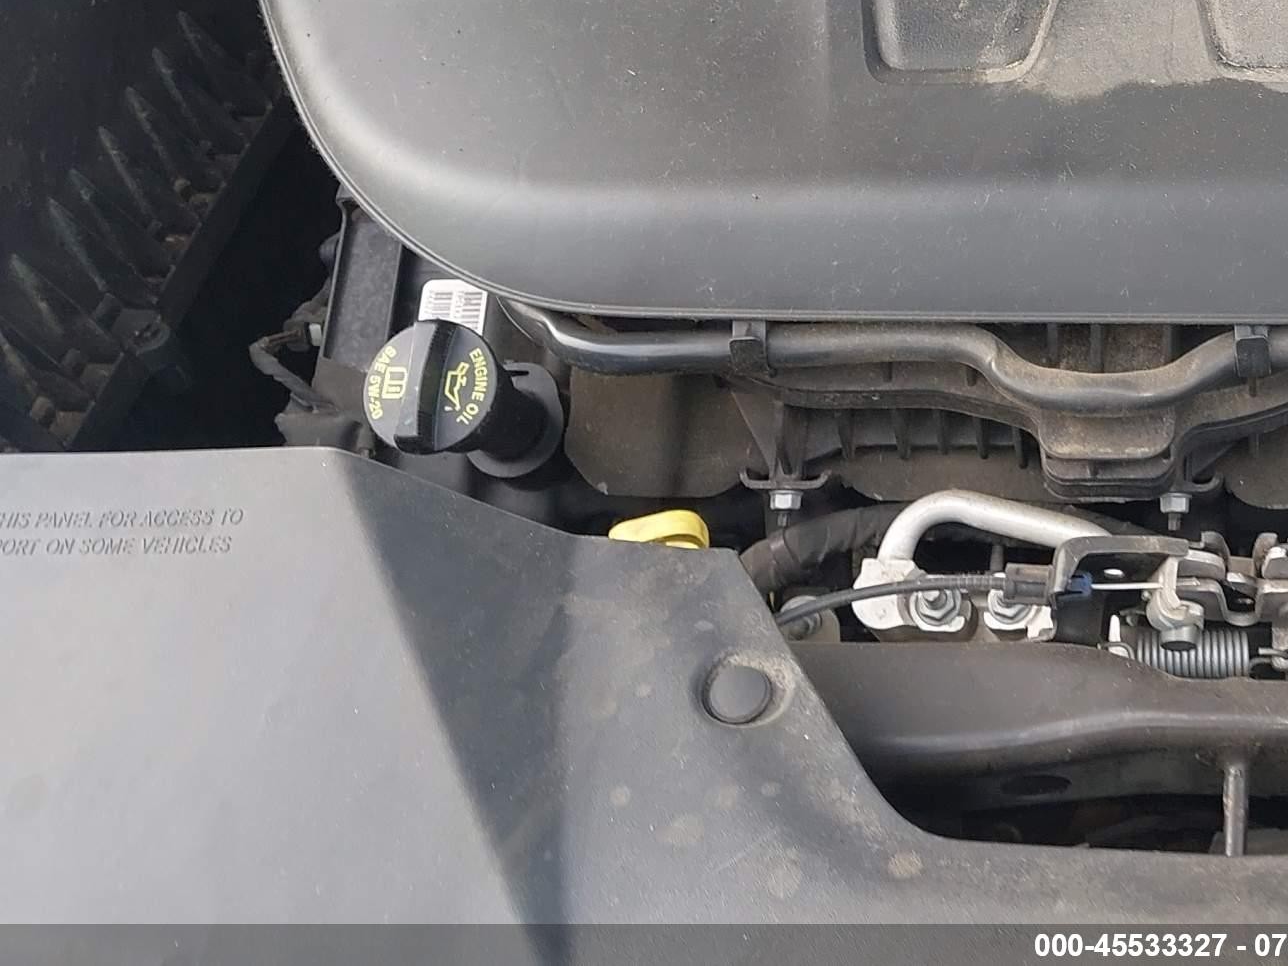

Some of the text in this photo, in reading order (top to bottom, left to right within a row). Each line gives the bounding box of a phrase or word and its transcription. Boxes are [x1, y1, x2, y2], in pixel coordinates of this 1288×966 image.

[367, 345, 397, 420] SAE 5W-20
[456, 347, 488, 425] ENGINE OIL
[0, 508, 244, 529] HIS PANEL FOR ACCESS TO
[0, 535, 233, 555] ORT ON SOME VEHICLES
